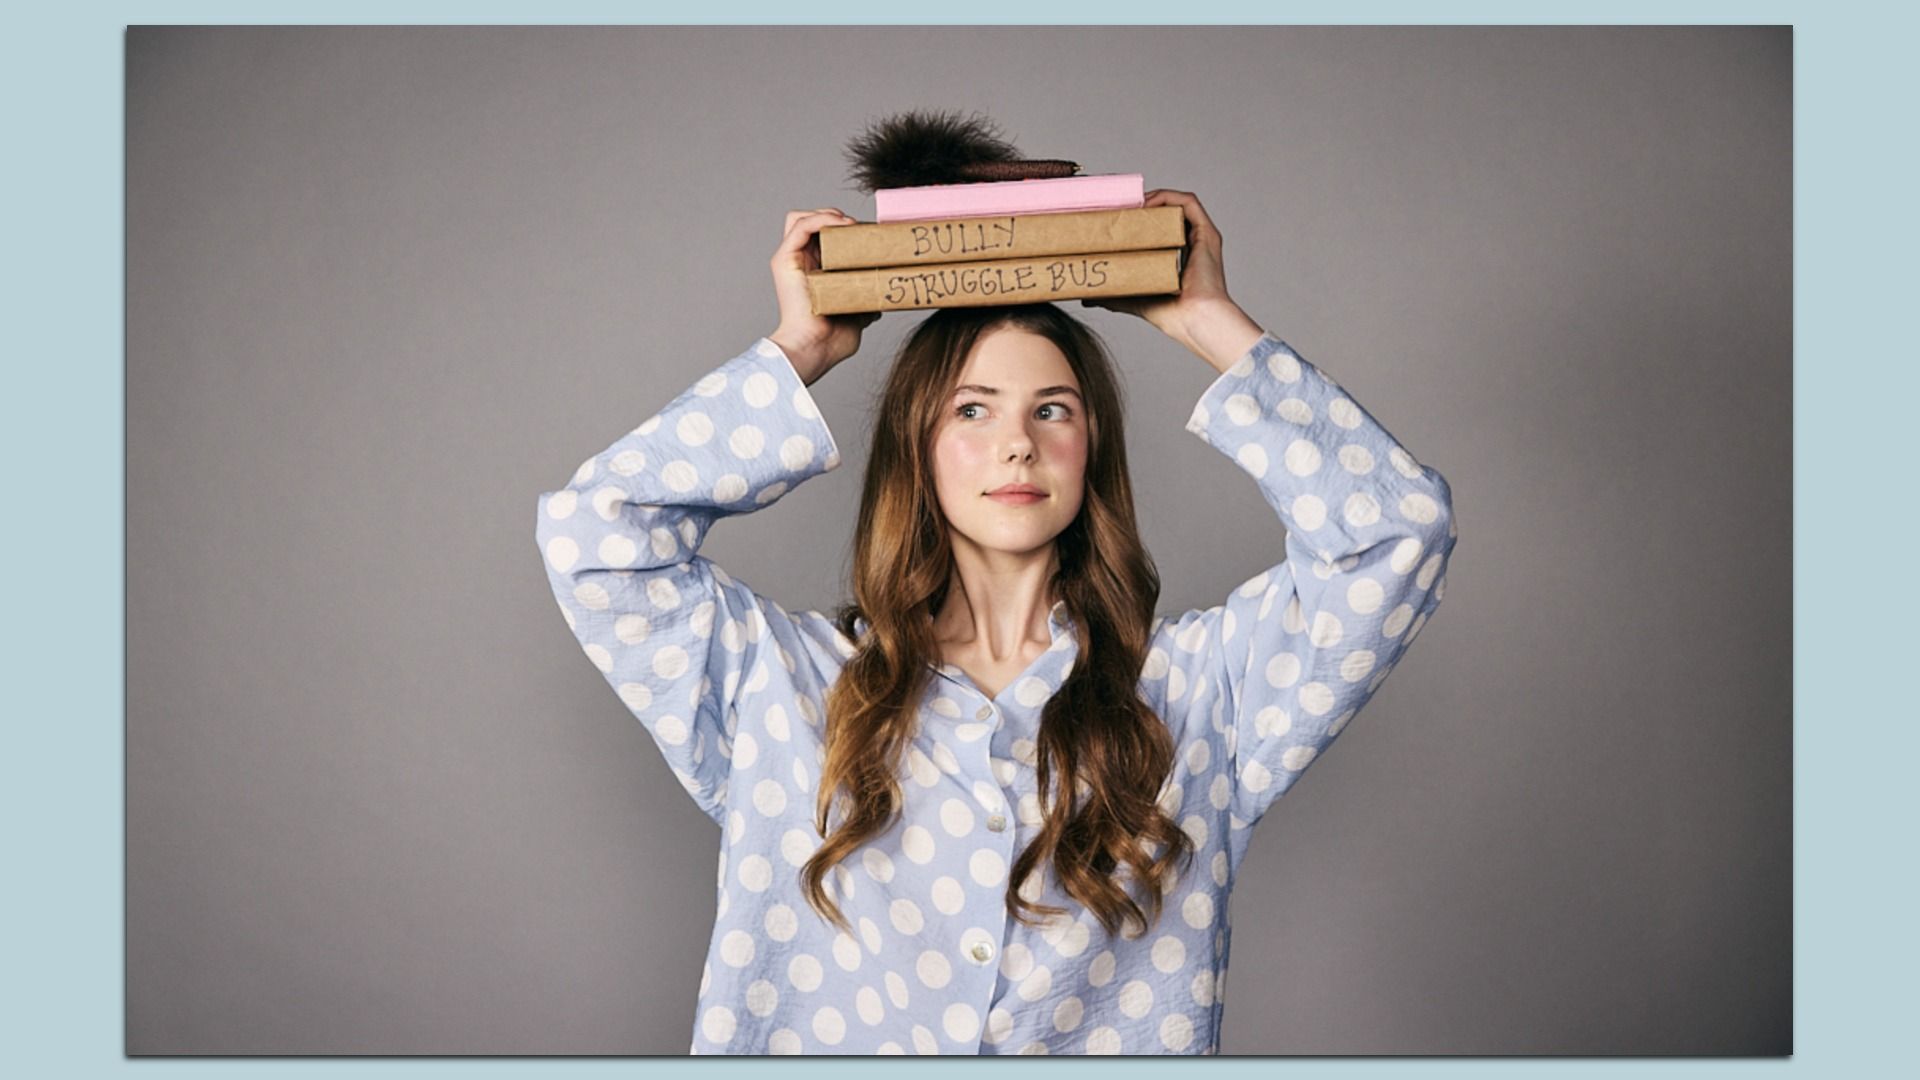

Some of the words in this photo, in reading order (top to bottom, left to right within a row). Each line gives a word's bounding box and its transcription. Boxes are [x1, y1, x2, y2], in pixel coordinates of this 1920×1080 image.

[911, 217, 1016, 256] BULLY
[885, 266, 1037, 304] STRUGGLE
[1046, 260, 1109, 292] BUS
